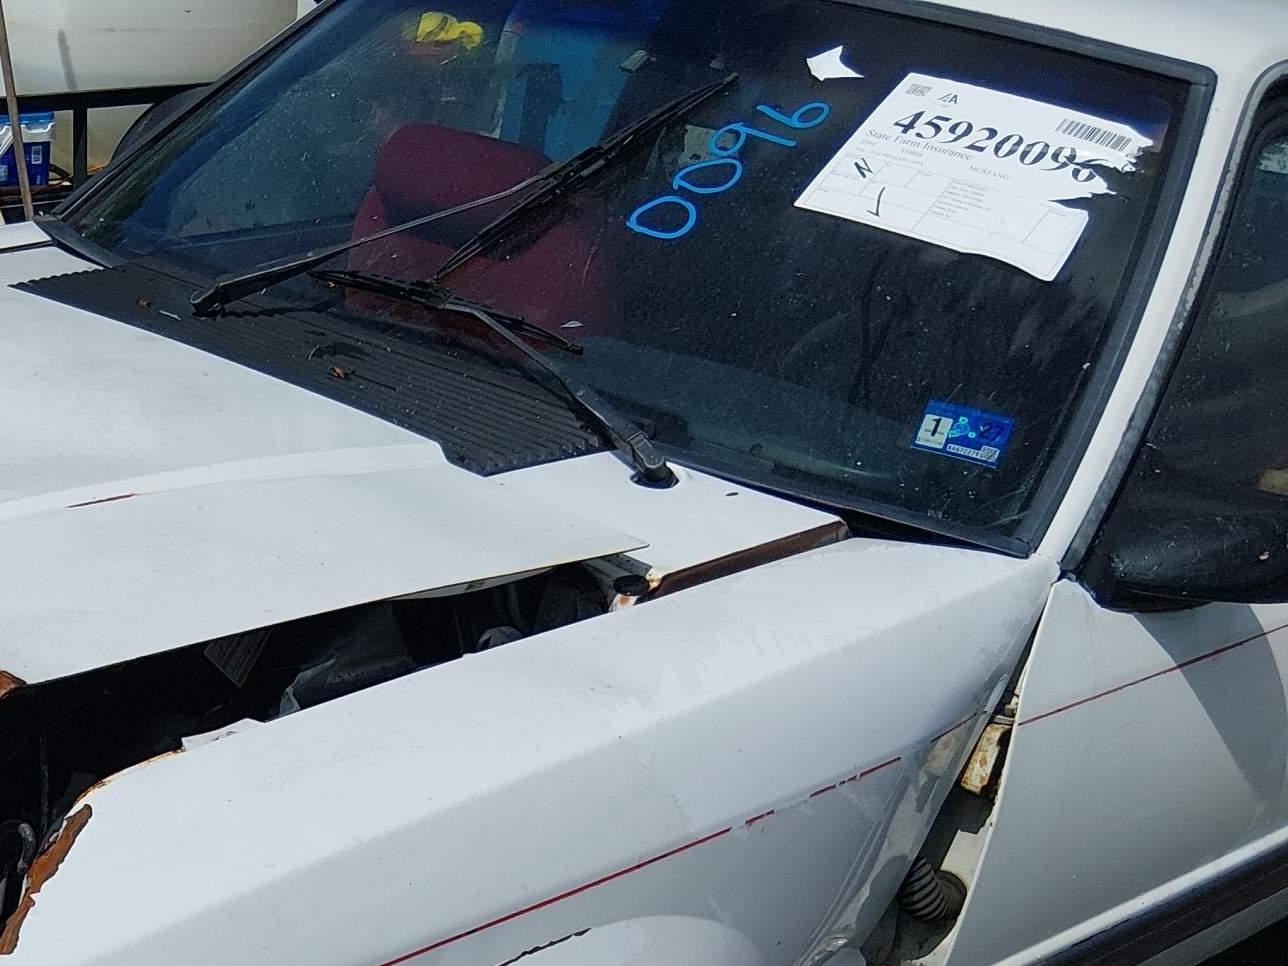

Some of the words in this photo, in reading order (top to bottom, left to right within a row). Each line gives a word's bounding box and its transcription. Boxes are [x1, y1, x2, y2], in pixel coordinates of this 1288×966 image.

[867, 129, 892, 143] State
[893, 135, 921, 150] Farm
[922, 141, 974, 162] Insurance
